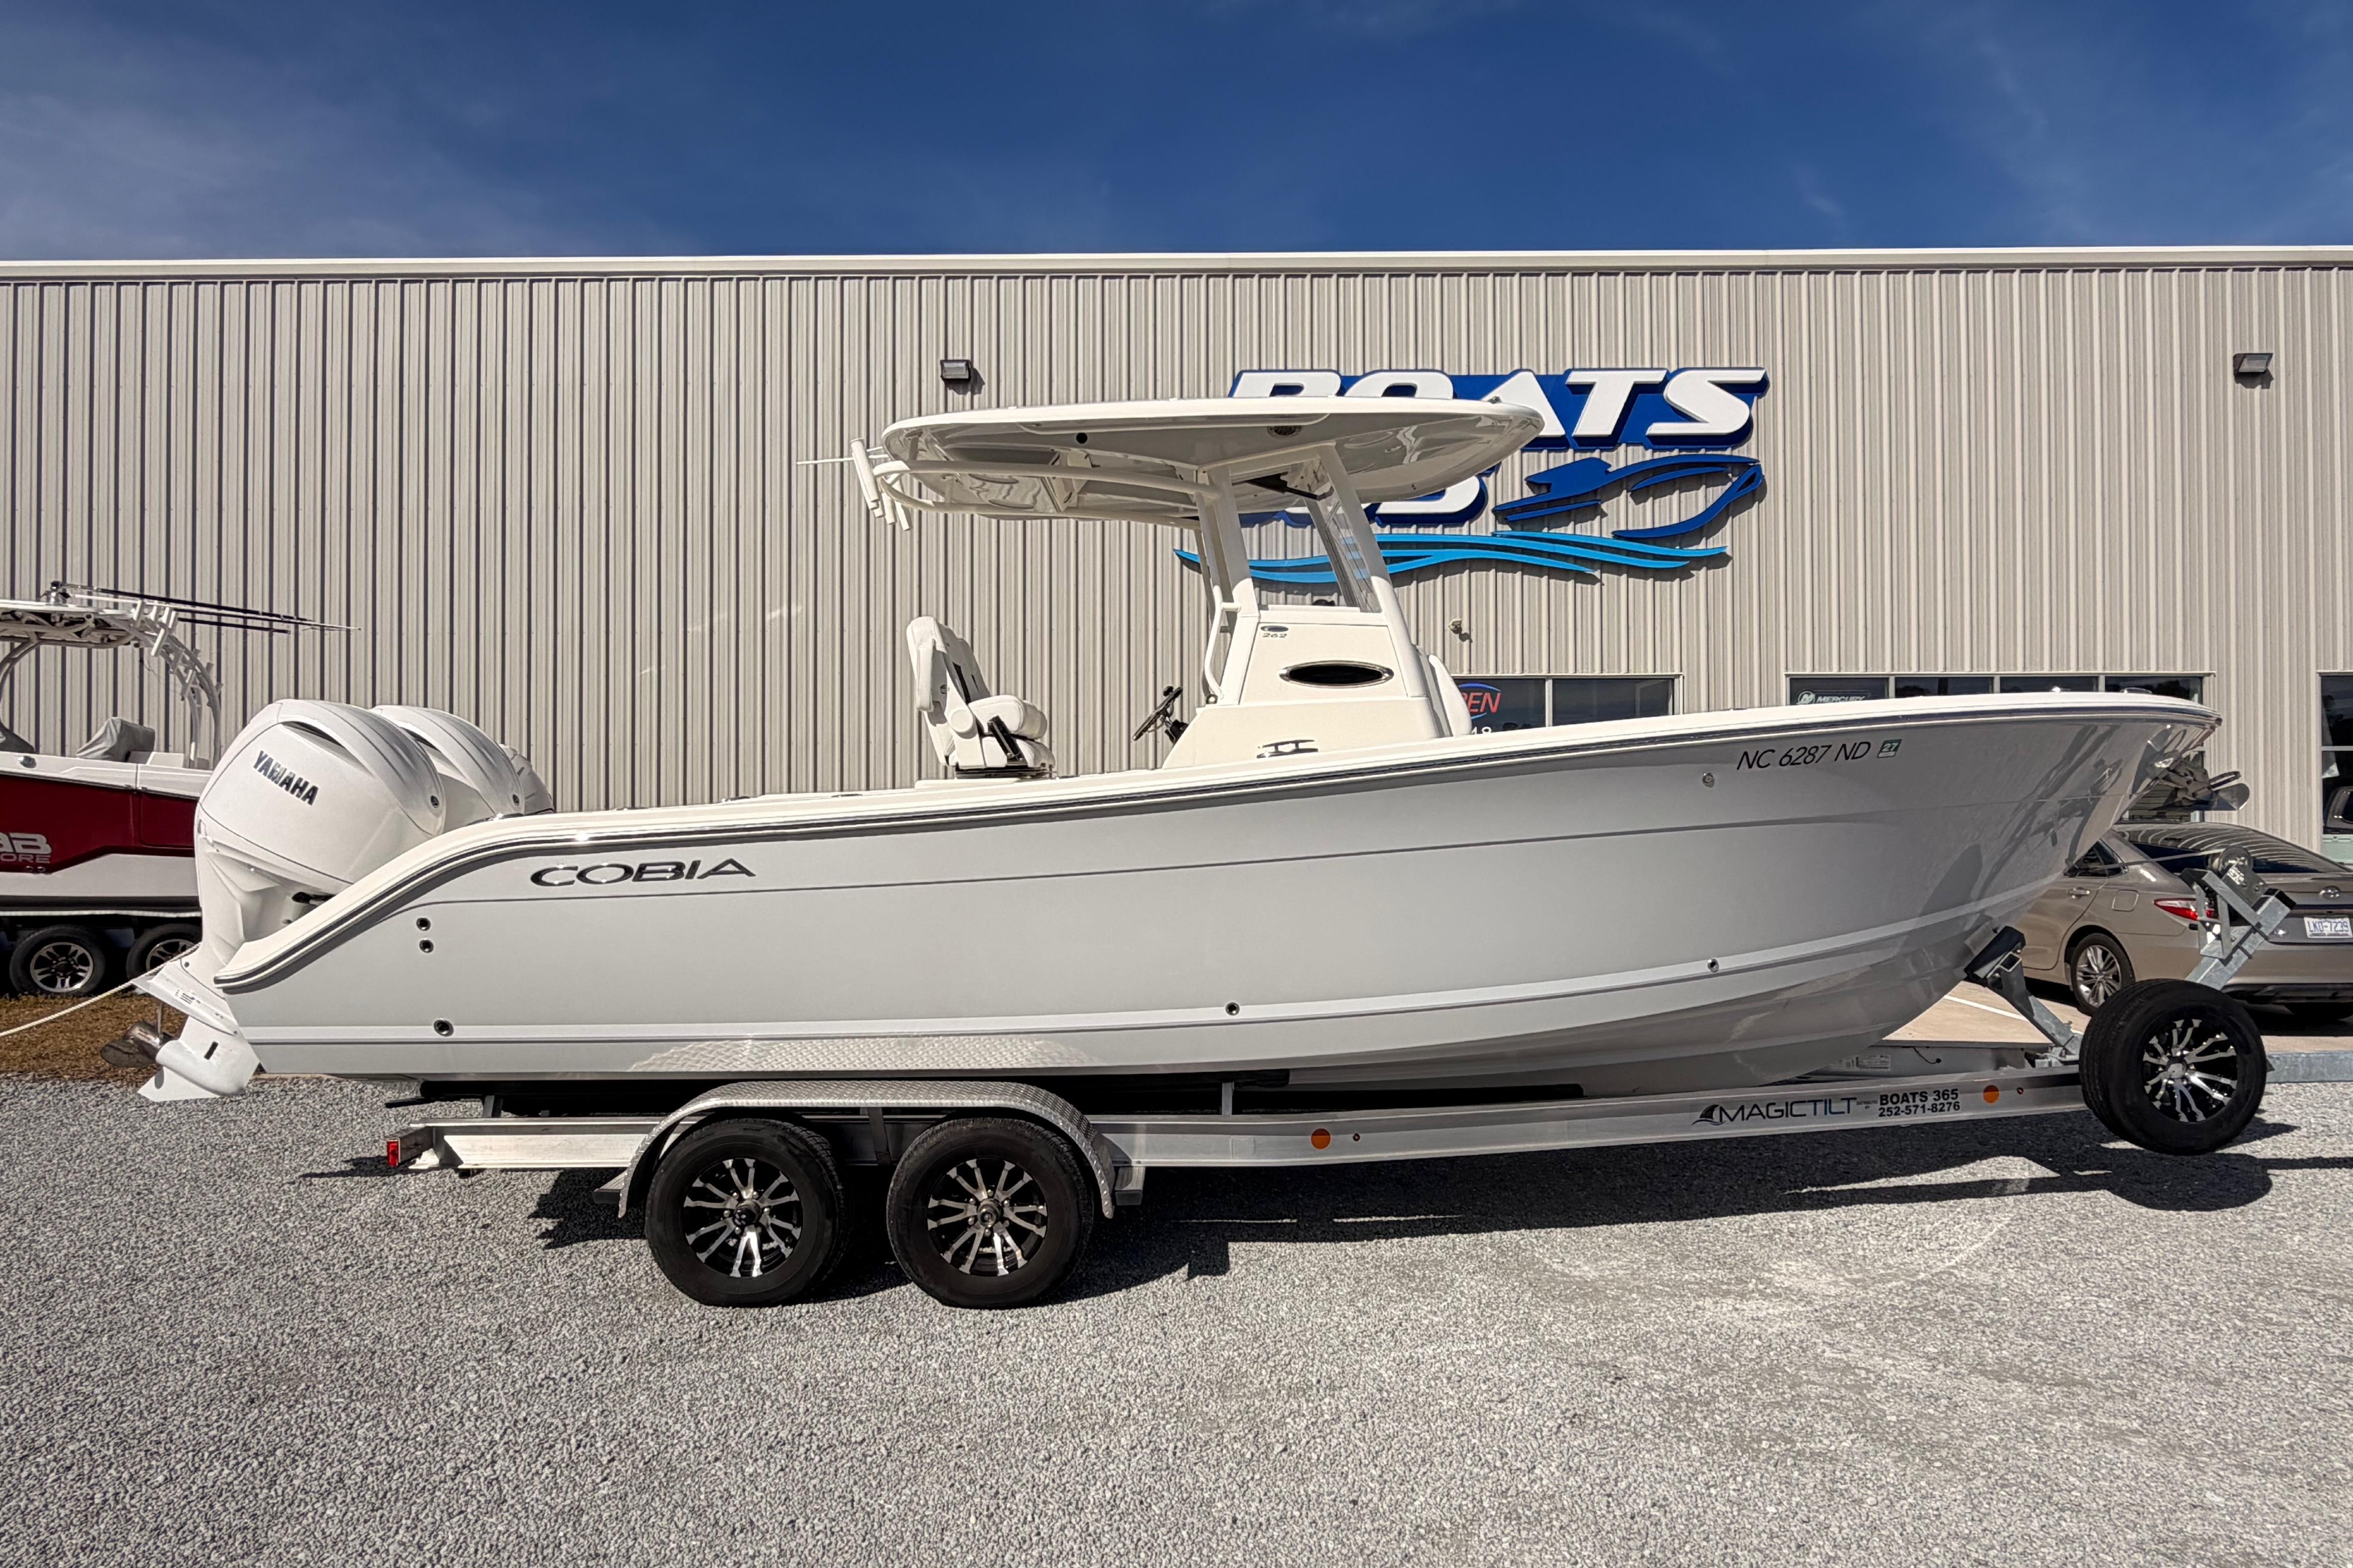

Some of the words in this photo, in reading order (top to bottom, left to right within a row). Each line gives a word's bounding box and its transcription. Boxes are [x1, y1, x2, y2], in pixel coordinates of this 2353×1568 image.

[1462, 692, 1501, 713] EN
[1737, 749, 1775, 770] NC
[1779, 745, 1833, 767] 6287
[1834, 741, 1871, 762] ND
[1882, 743, 1896, 752] 27
[253, 750, 319, 805] YAMAHA
[530, 858, 756, 886] COBIA
[1880, 1091, 1928, 1105] BOATS
[1933, 1088, 1958, 1101] 365
[1720, 1097, 1857, 1123] MAGICTILT
[1878, 1101, 1960, 1117] 252-571-8276
